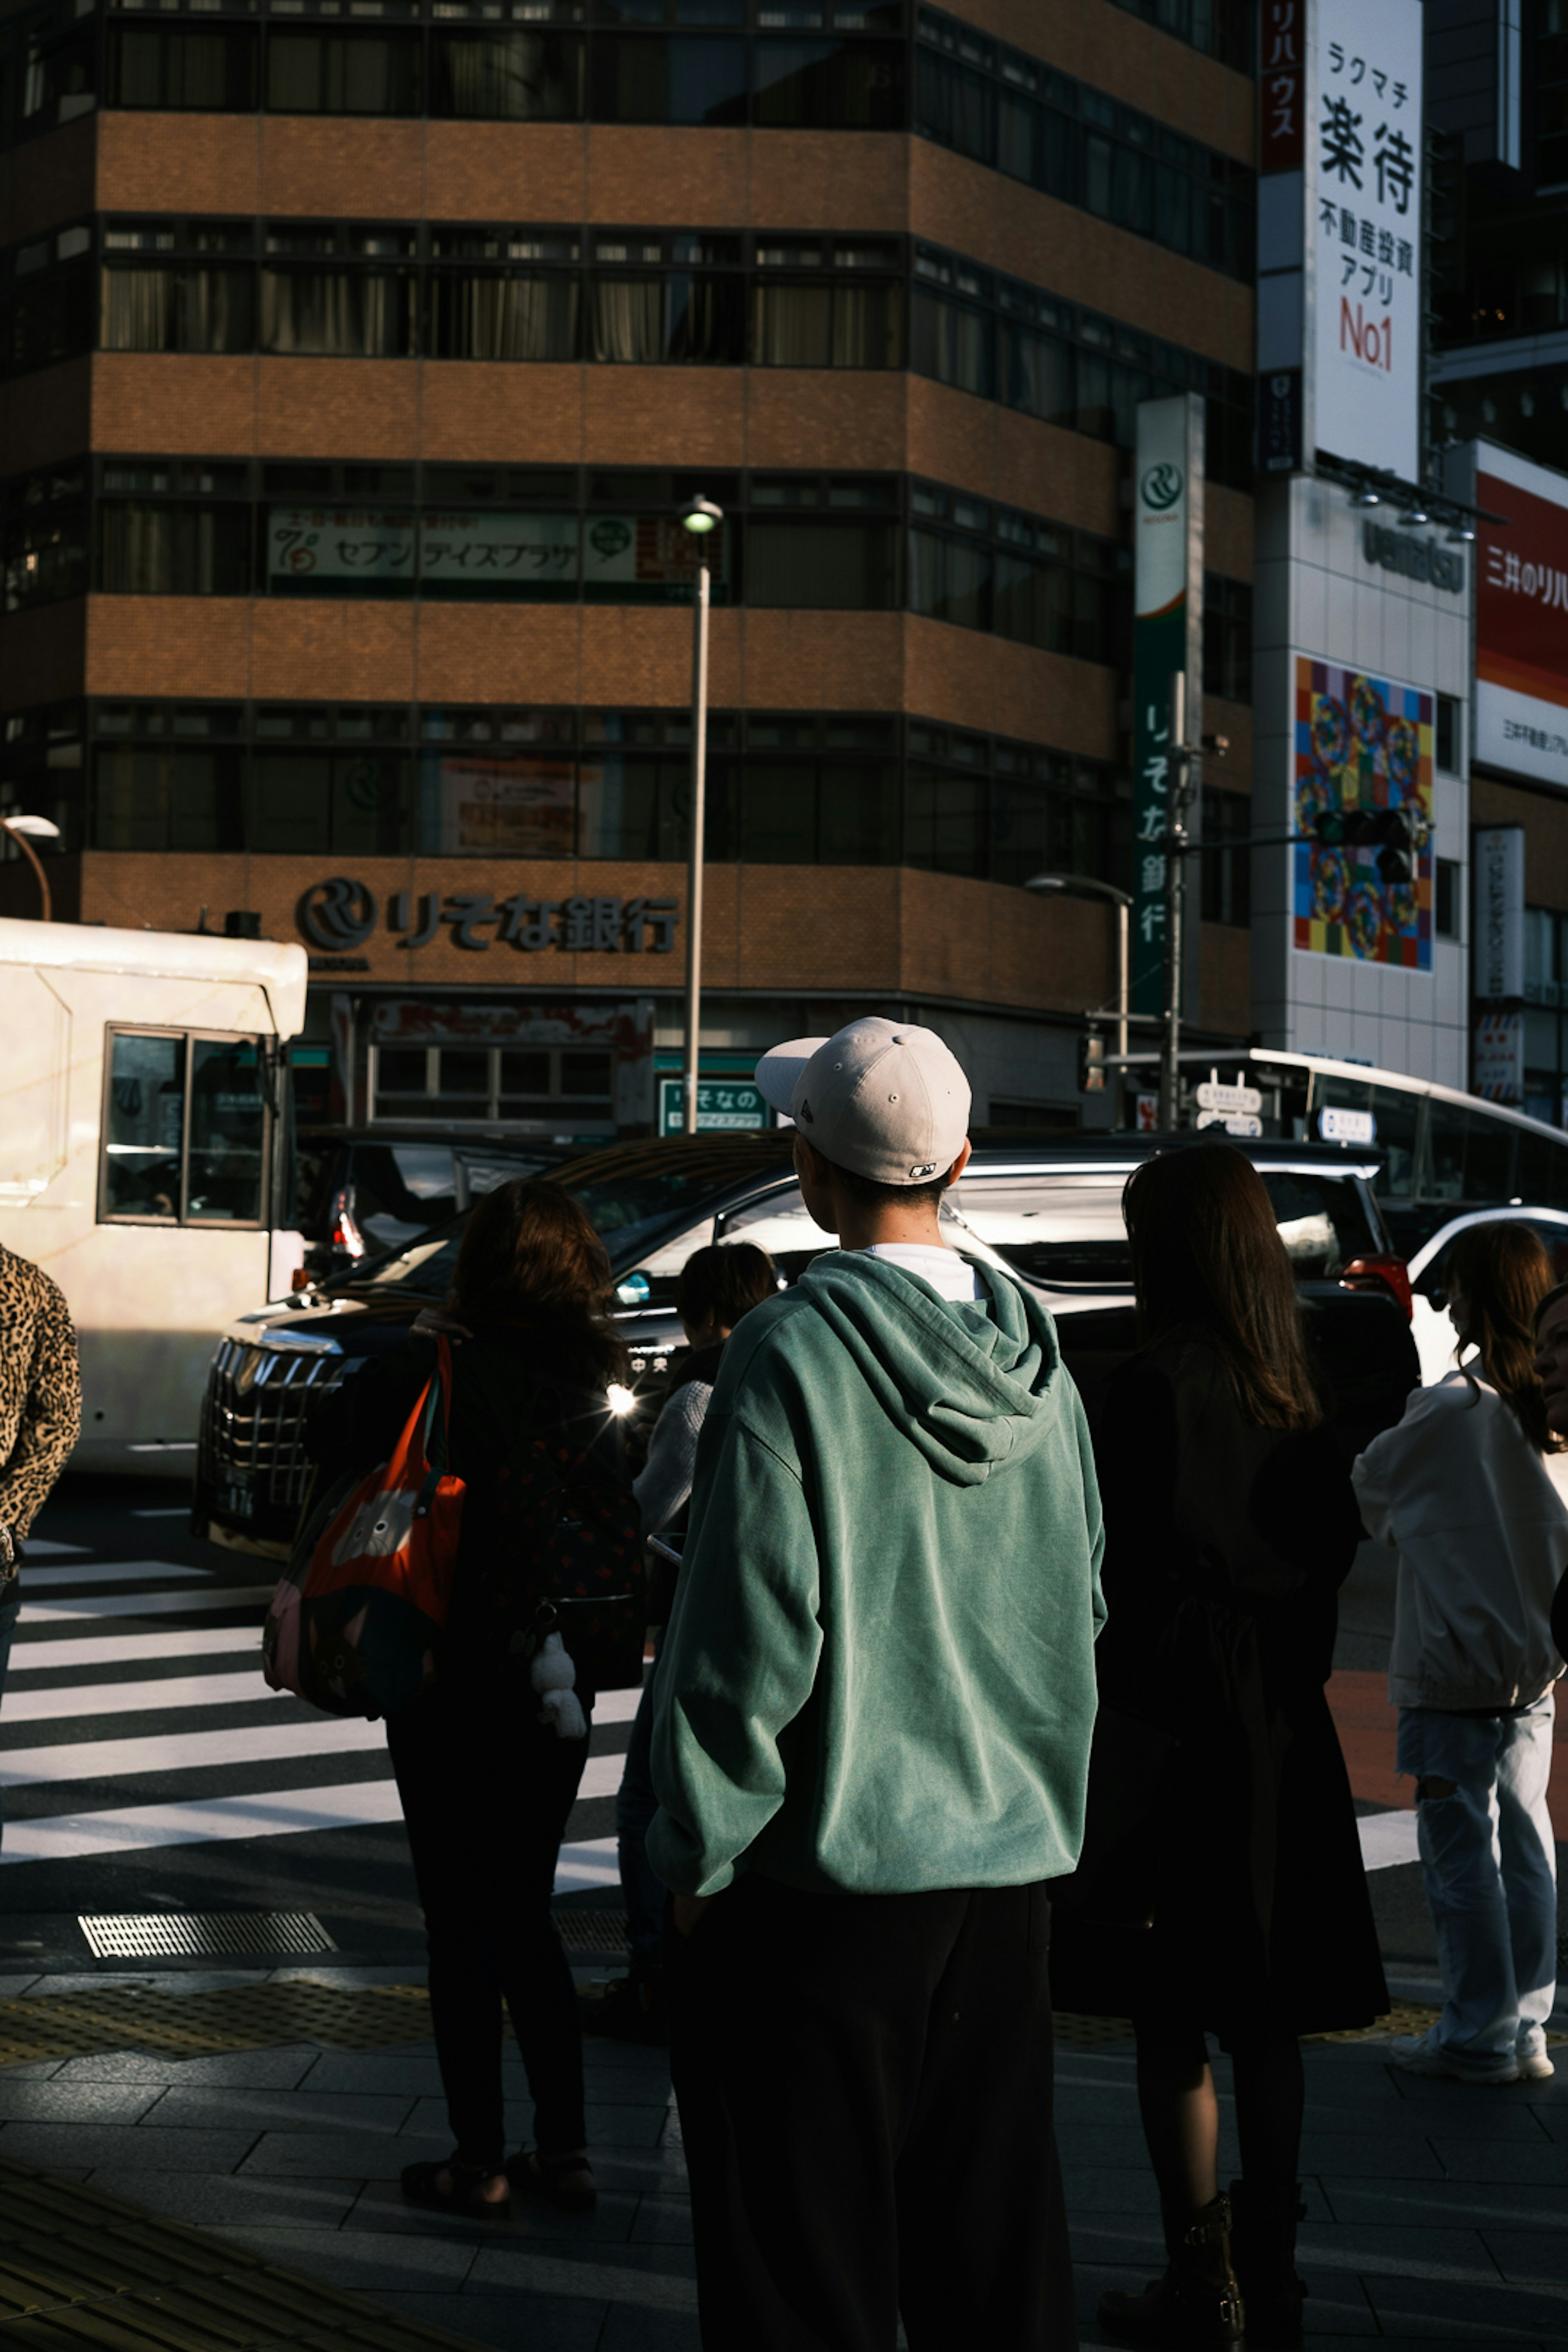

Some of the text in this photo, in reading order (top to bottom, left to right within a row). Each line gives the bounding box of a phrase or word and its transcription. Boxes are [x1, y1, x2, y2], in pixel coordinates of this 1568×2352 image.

[1269, 1, 1296, 140] リハウス
[1329, 42, 1408, 109] ラクマチ
[1320, 93, 1414, 215] 楽待
[1319, 197, 1413, 270] 不動産投資
[1341, 254, 1393, 306] アプリ
[387, 892, 681, 953] りそな銀行
